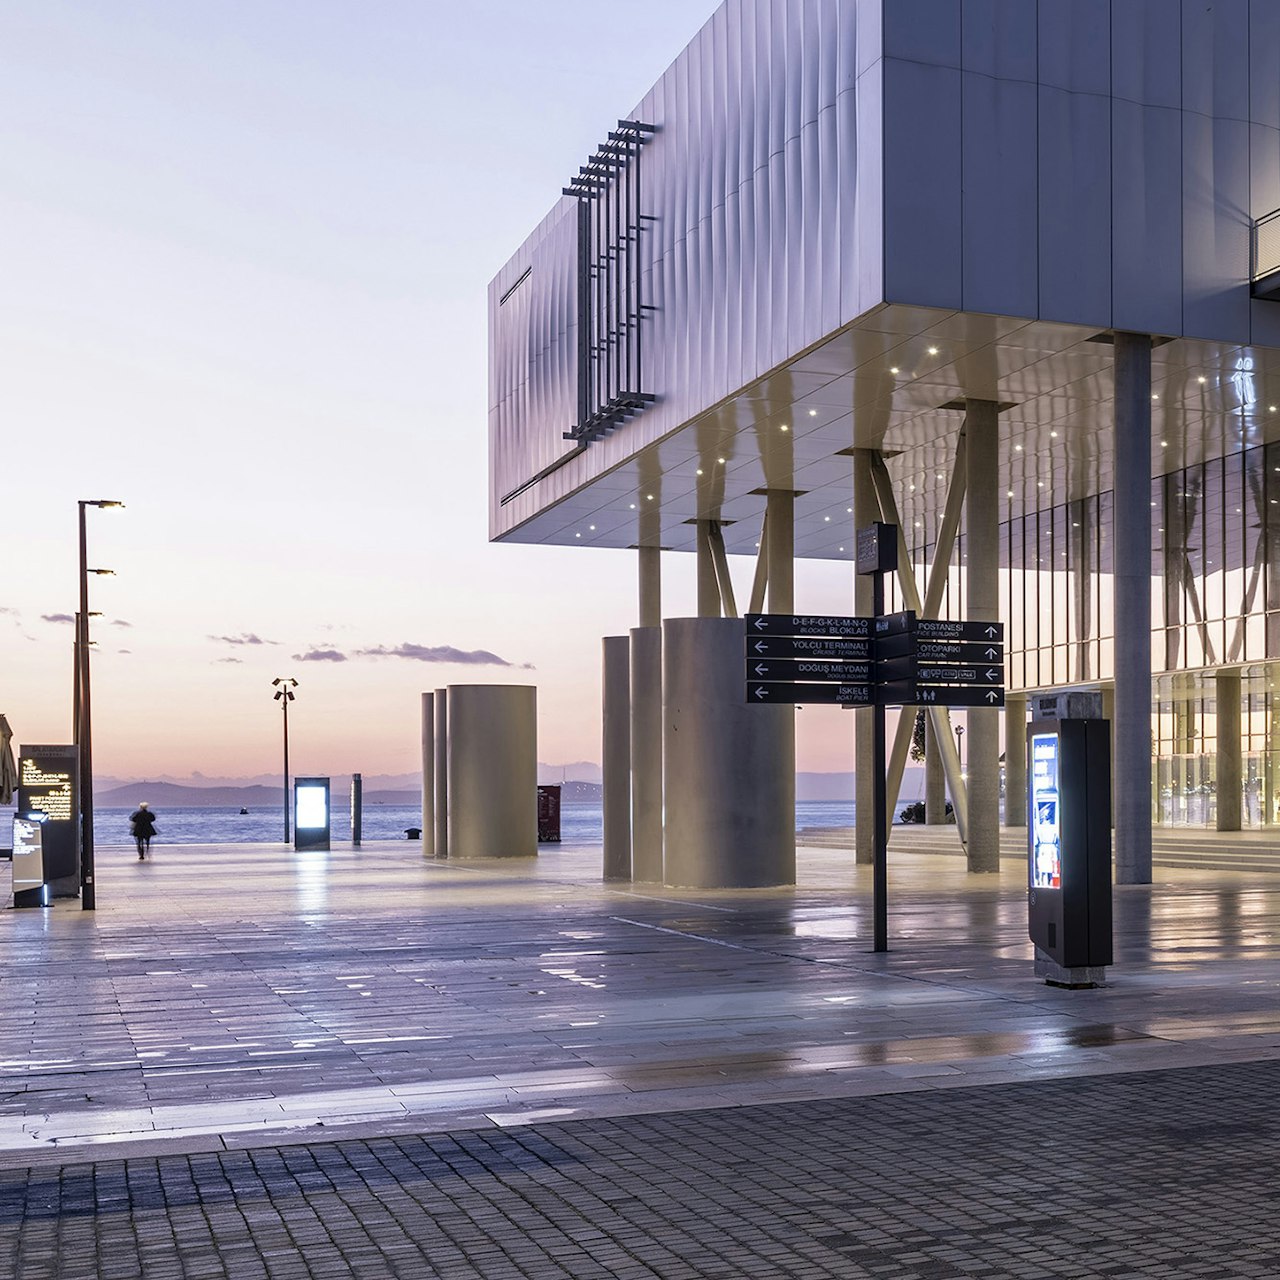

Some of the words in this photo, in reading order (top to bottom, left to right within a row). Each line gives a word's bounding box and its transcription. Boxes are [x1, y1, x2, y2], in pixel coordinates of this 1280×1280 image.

[829, 626, 868, 635] BLOKLAR
[918, 623, 964, 631] POSTANESİ
[792, 640, 822, 649] YOLCU
[920, 644, 961, 653] OTOPARKI
[831, 665, 868, 673] MEYDANI
[839, 686, 868, 695] İSKELE
